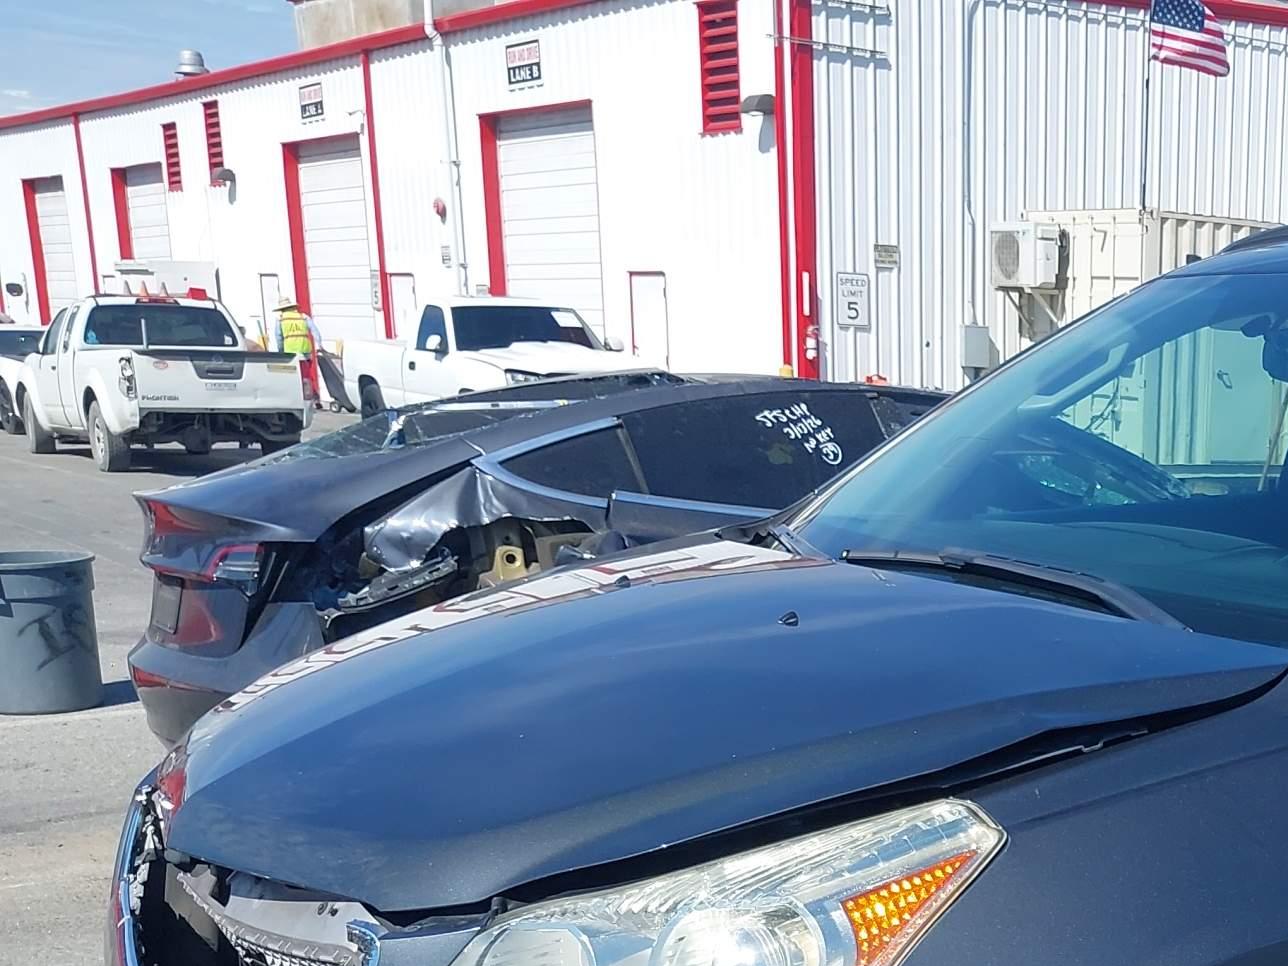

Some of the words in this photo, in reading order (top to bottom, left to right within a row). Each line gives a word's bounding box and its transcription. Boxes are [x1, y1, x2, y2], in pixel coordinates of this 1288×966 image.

[510, 66, 532, 82] LANE
[532, 65, 539, 78] B
[839, 278, 867, 287] SPEED
[842, 289, 864, 298] LIMIT
[847, 301, 859, 320] 5
[815, 427, 835, 443] KEY
